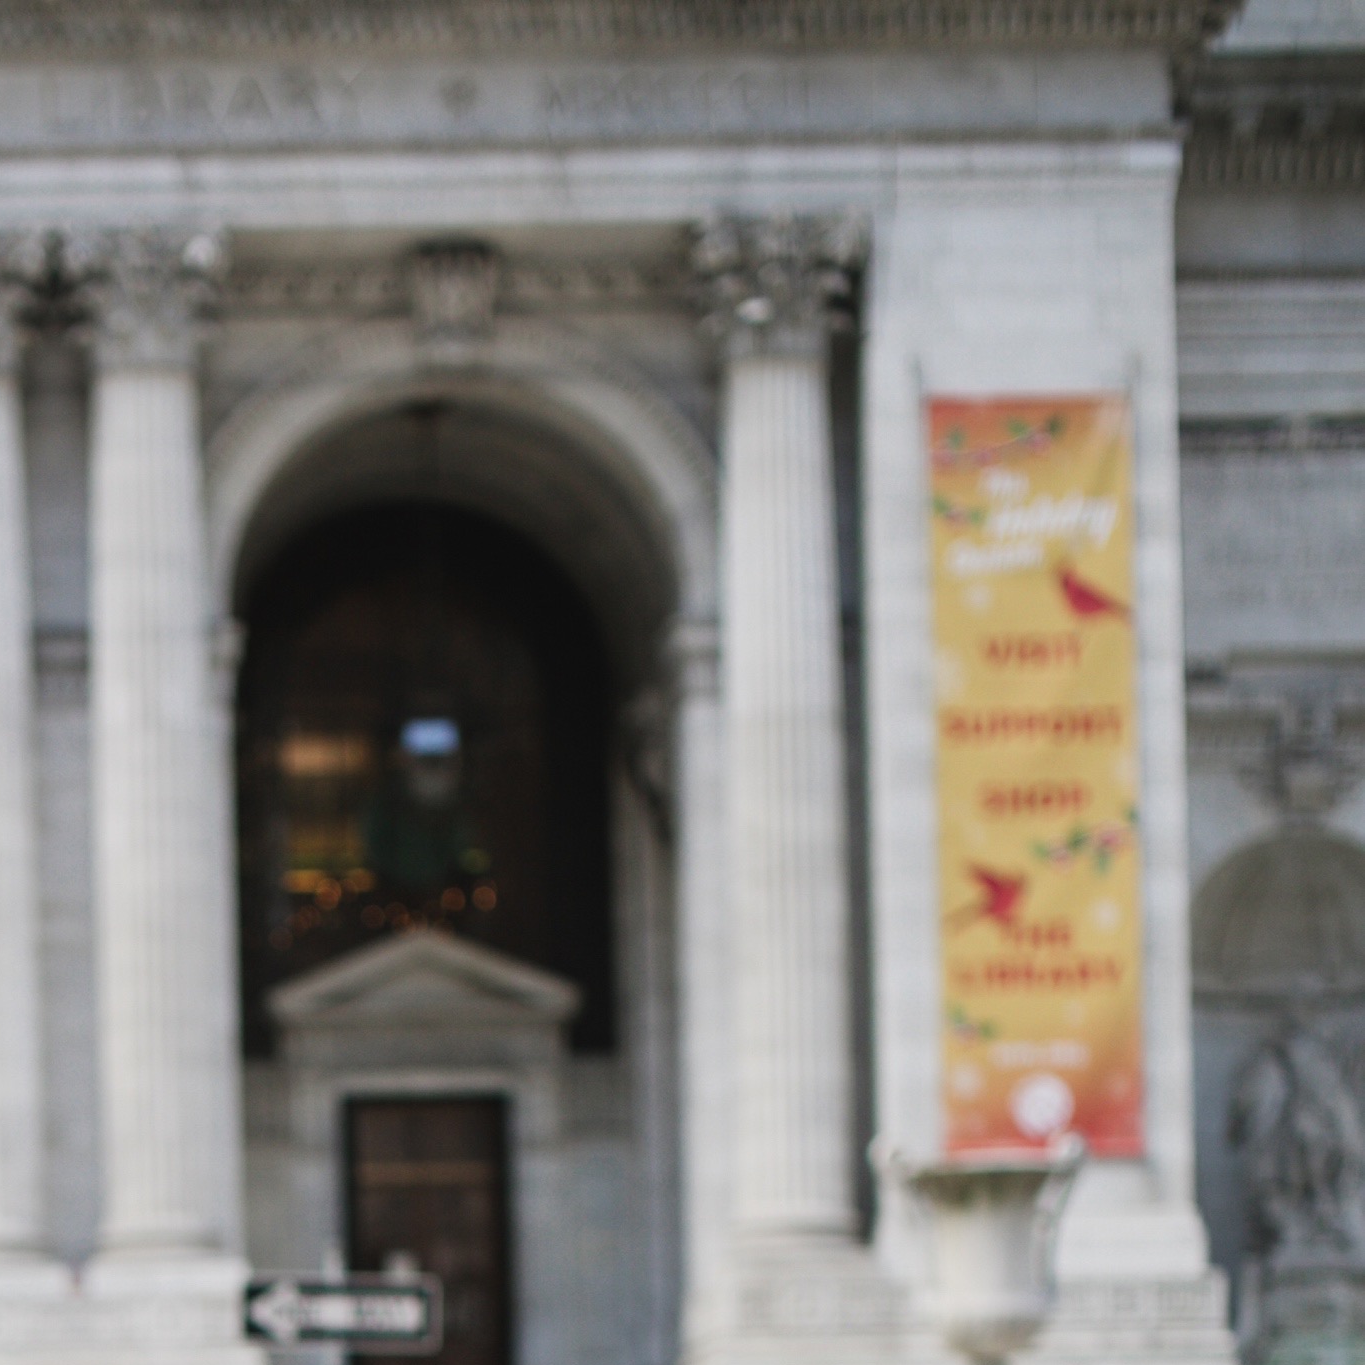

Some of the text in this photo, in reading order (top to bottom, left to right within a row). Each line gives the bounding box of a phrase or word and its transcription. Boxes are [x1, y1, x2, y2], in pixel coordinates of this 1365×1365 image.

[981, 634, 1083, 670] VISIT
[942, 710, 1123, 743] SUPPORT
[980, 785, 1090, 817] SHOP
[954, 958, 1122, 990] LIBRARY
